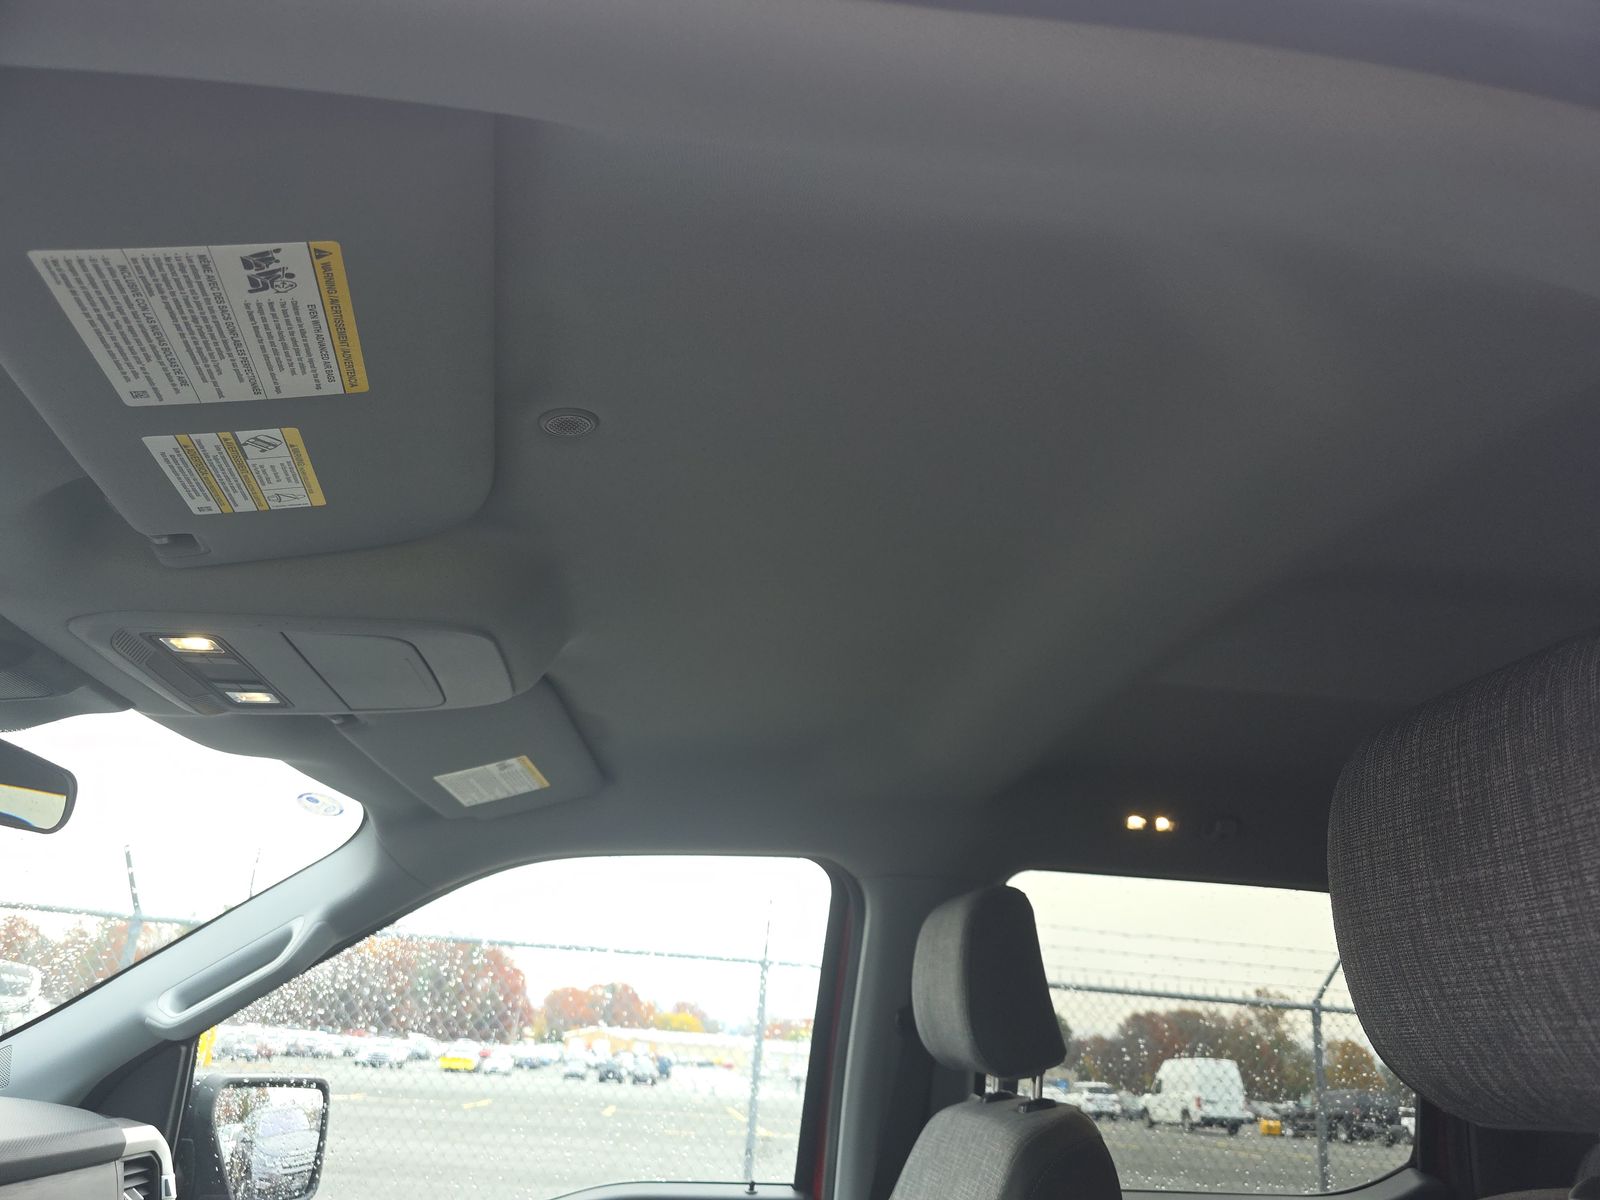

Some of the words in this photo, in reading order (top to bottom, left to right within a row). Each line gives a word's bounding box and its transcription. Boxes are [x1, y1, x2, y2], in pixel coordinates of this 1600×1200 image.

[205, 274, 219, 290] AVEC
[321, 261, 336, 294] WARNING
[212, 292, 225, 304] DES
[217, 305, 231, 320] SACS
[307, 304, 318, 318] EVEN
[117, 264, 142, 297] INCLUSIVE
[135, 298, 149, 311] CON
[142, 312, 156, 323] LAS
[149, 324, 167, 346] NUEVAS
[161, 347, 178, 367] BOLSAS
[176, 376, 189, 386] AIRE
[311, 319, 321, 332] WITH
[225, 321, 245, 355] GONFLABLES
[315, 333, 329, 360] ADVANCED
[323, 361, 331, 369] AIR
[325, 369, 335, 382] BAGS
